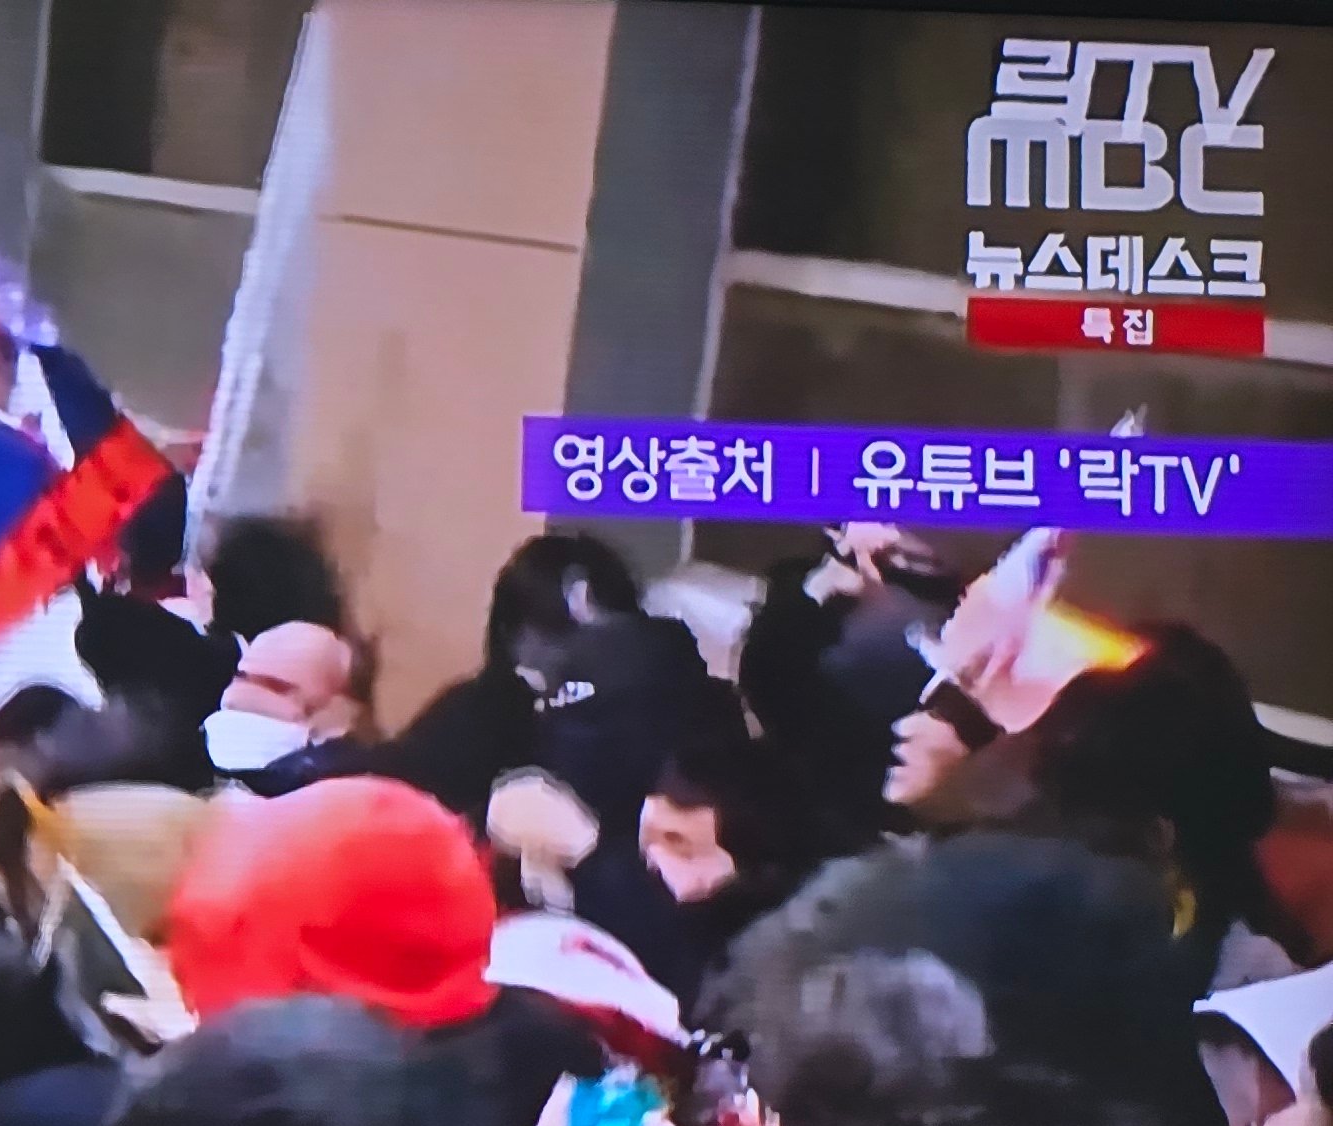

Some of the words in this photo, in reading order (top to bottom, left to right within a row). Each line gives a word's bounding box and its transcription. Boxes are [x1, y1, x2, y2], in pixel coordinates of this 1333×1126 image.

[966, 115, 1264, 216] MBC
[965, 230, 1266, 297] 뉴스데스크
[552, 434, 774, 504] 영상출처
[852, 440, 1041, 510] 유튜브
